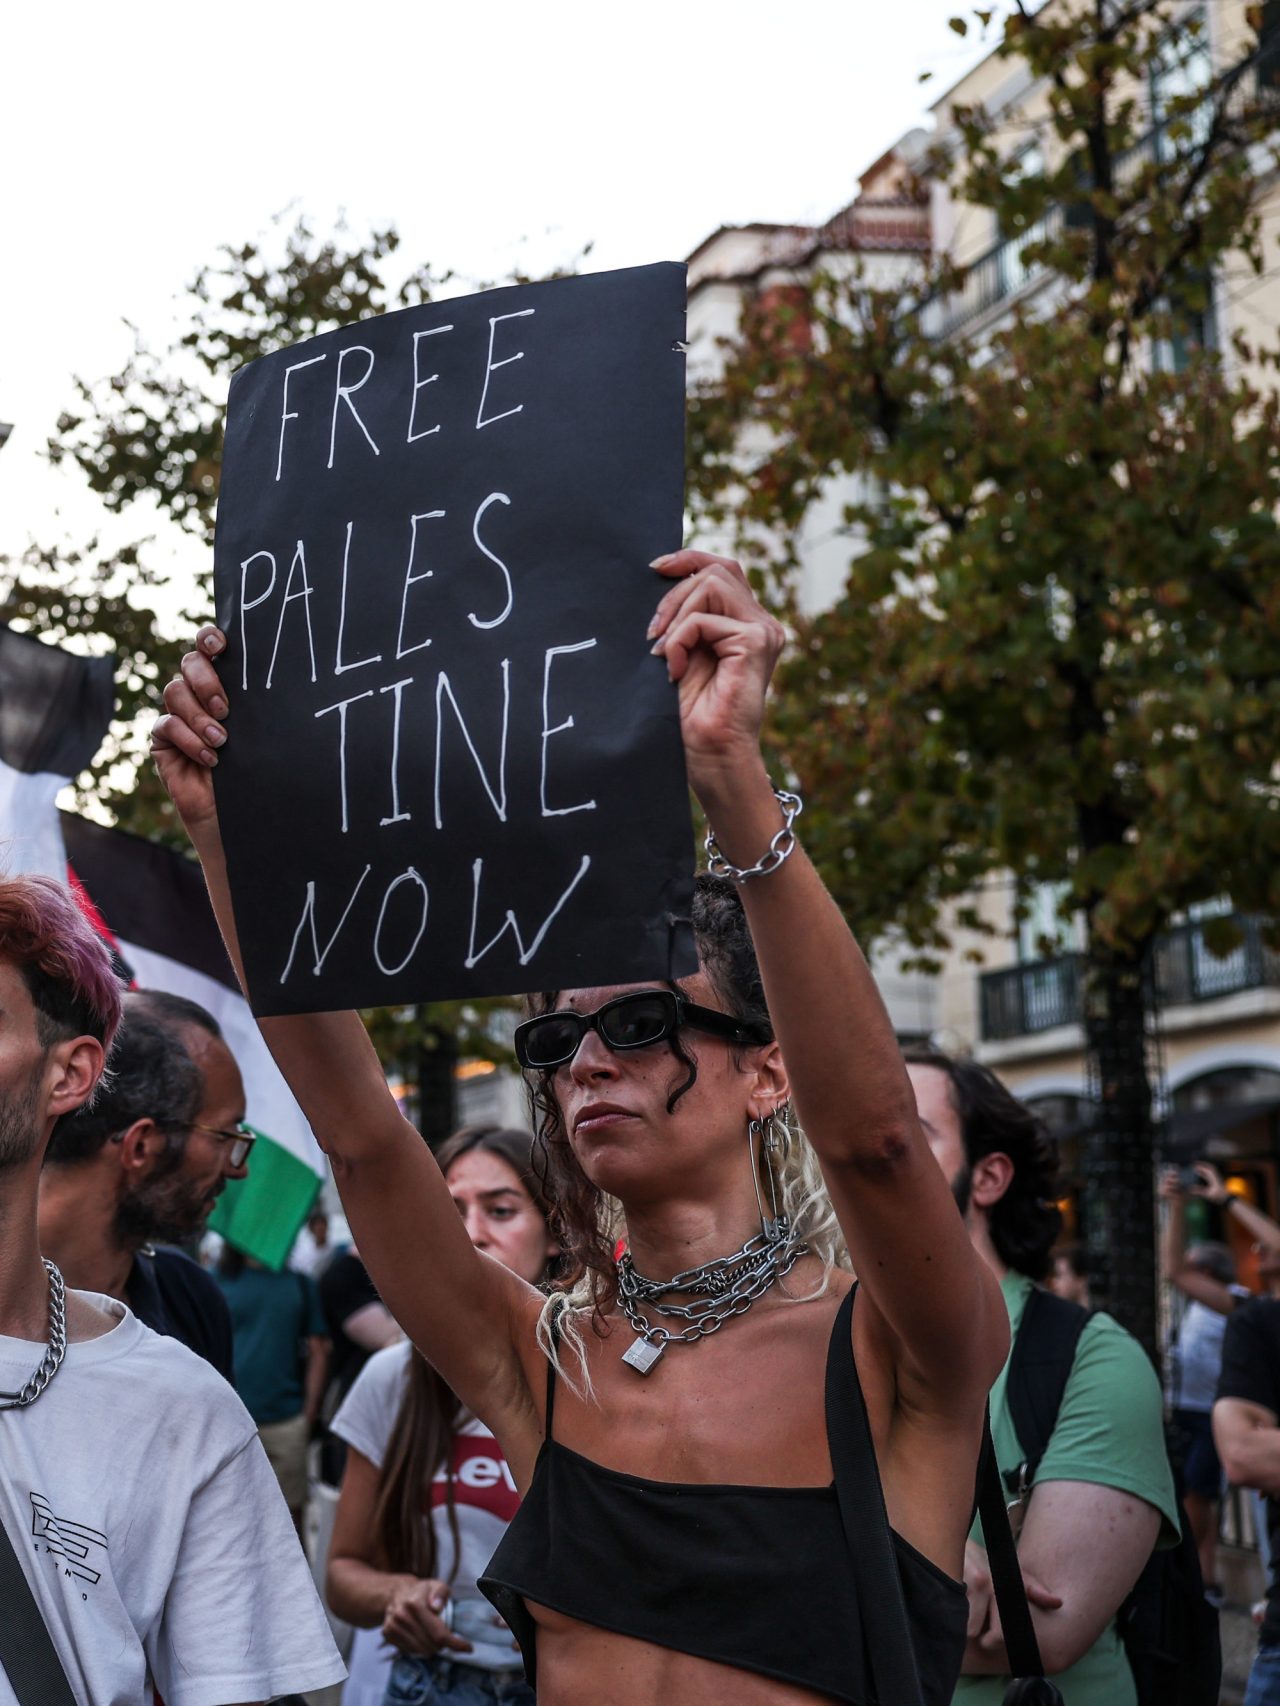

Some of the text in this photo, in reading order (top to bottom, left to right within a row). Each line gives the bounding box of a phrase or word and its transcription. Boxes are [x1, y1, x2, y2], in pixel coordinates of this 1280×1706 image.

[275, 308, 536, 481] FREE
[238, 492, 514, 691] PALES
[314, 638, 597, 833] TINE
[279, 855, 592, 985] NOW
